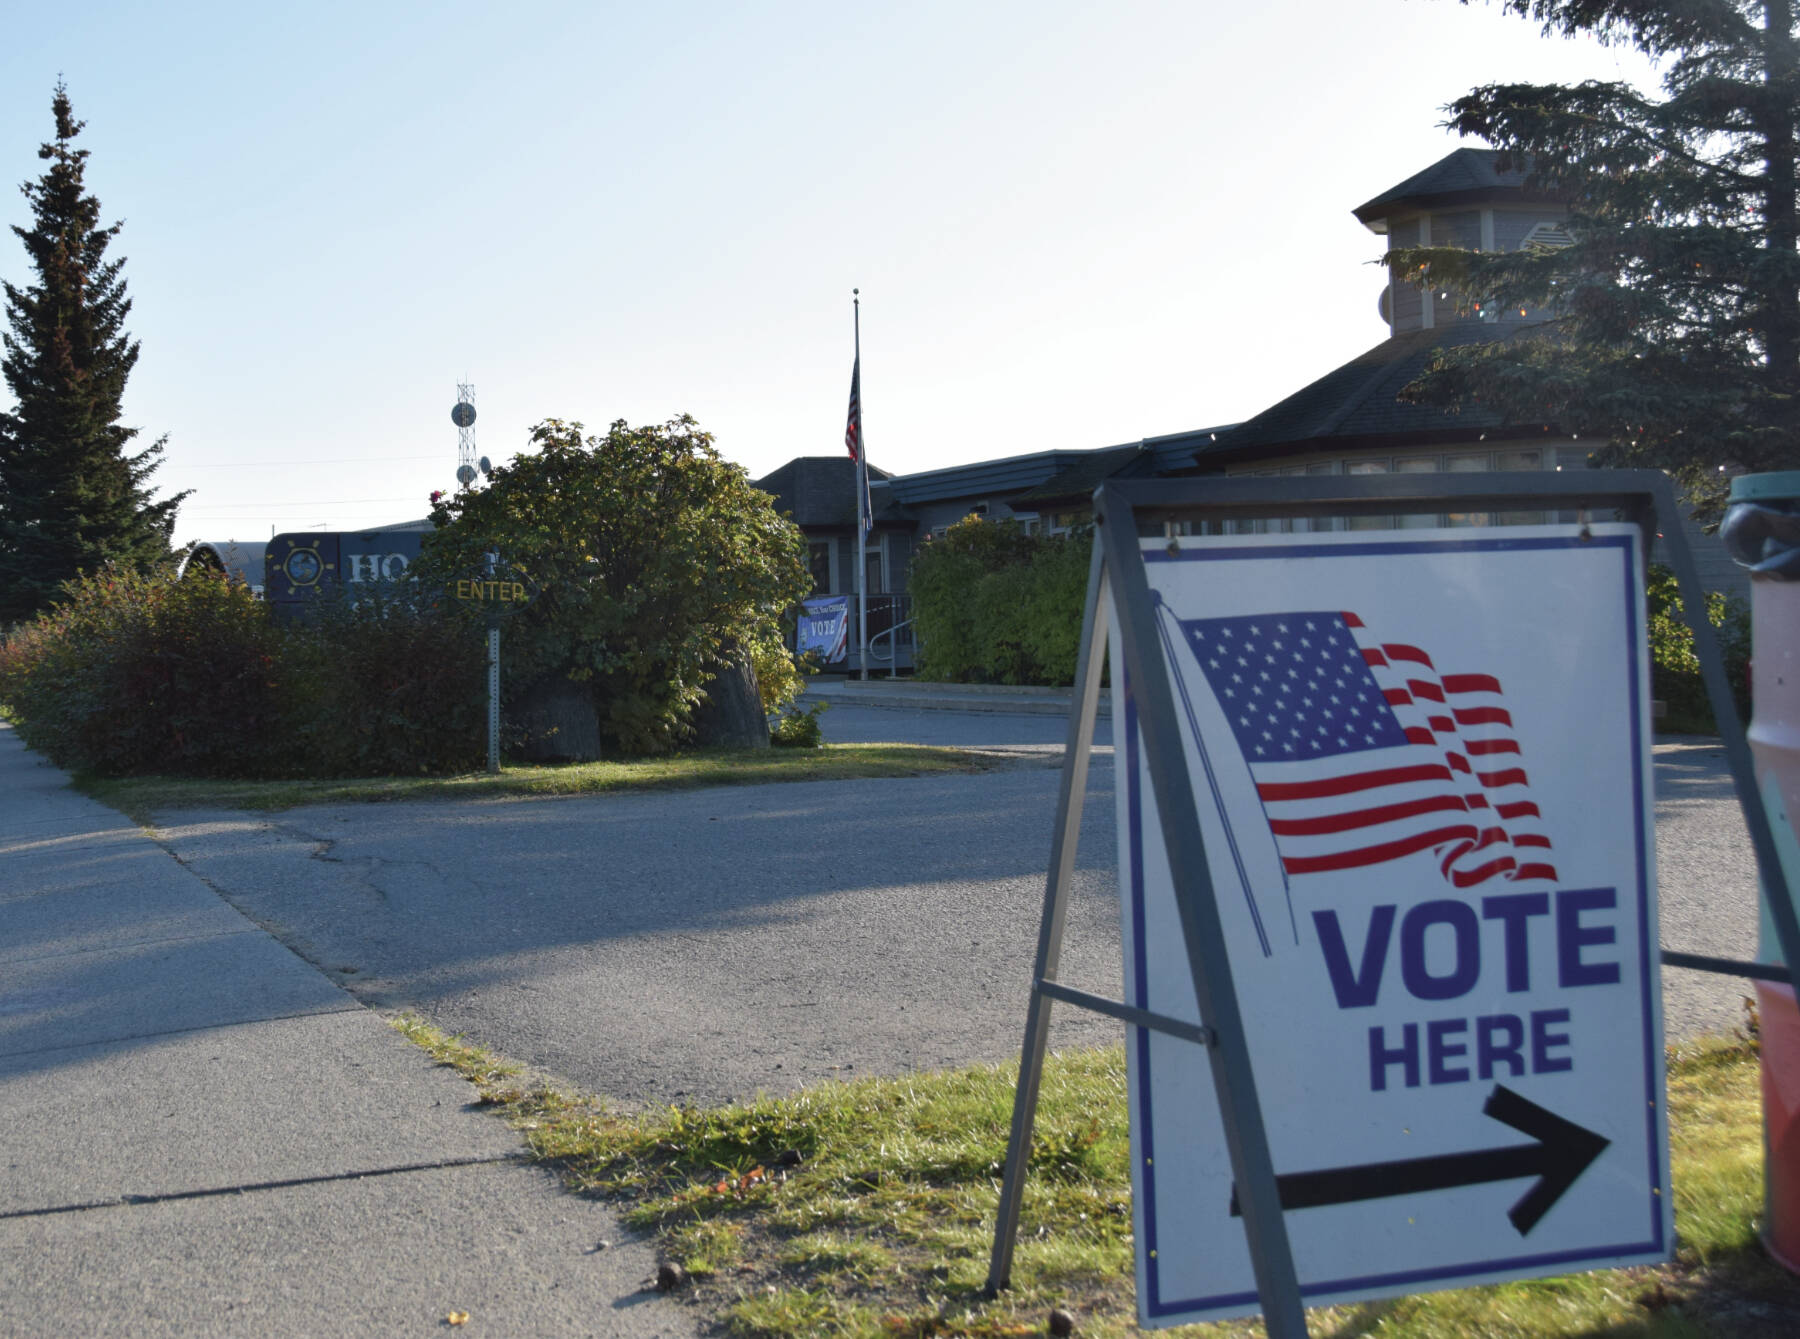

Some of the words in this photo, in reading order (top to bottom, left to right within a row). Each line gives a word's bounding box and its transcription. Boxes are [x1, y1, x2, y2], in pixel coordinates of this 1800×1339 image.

[456, 579, 526, 602] ENTER
[811, 619, 836, 637] VOTE
[1311, 886, 1621, 1010] VOTE
[1368, 1007, 1574, 1092] HERE
